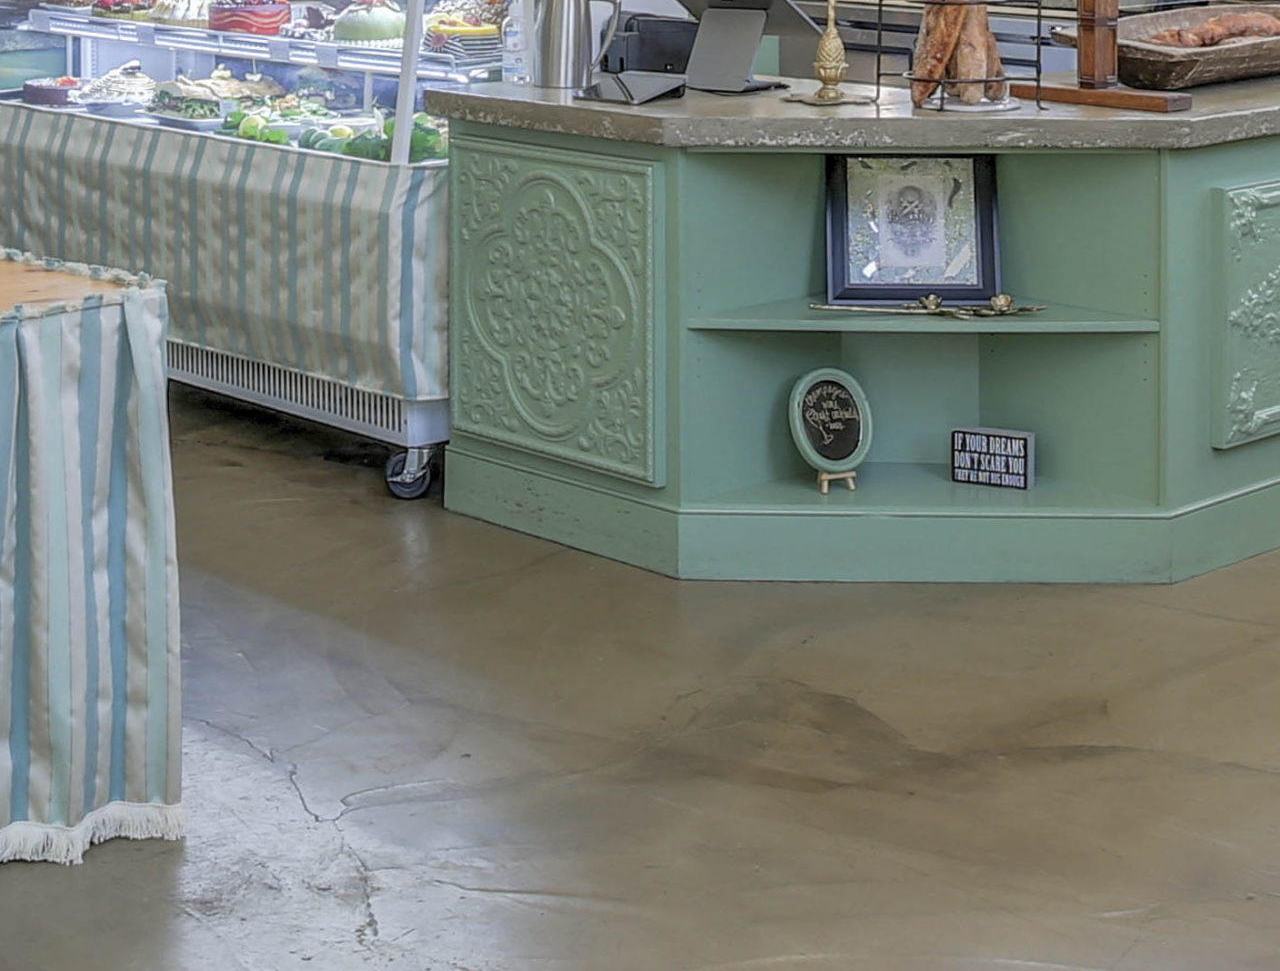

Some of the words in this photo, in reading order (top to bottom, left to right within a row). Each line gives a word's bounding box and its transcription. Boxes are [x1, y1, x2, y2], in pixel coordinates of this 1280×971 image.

[954, 432, 964, 451] IF
[965, 433, 988, 453] YOUR
[989, 436, 1025, 457] DREAMS
[954, 450, 980, 470] DON'T
[980, 453, 1007, 473] SCARE
[1008, 457, 1025, 475] YOU
